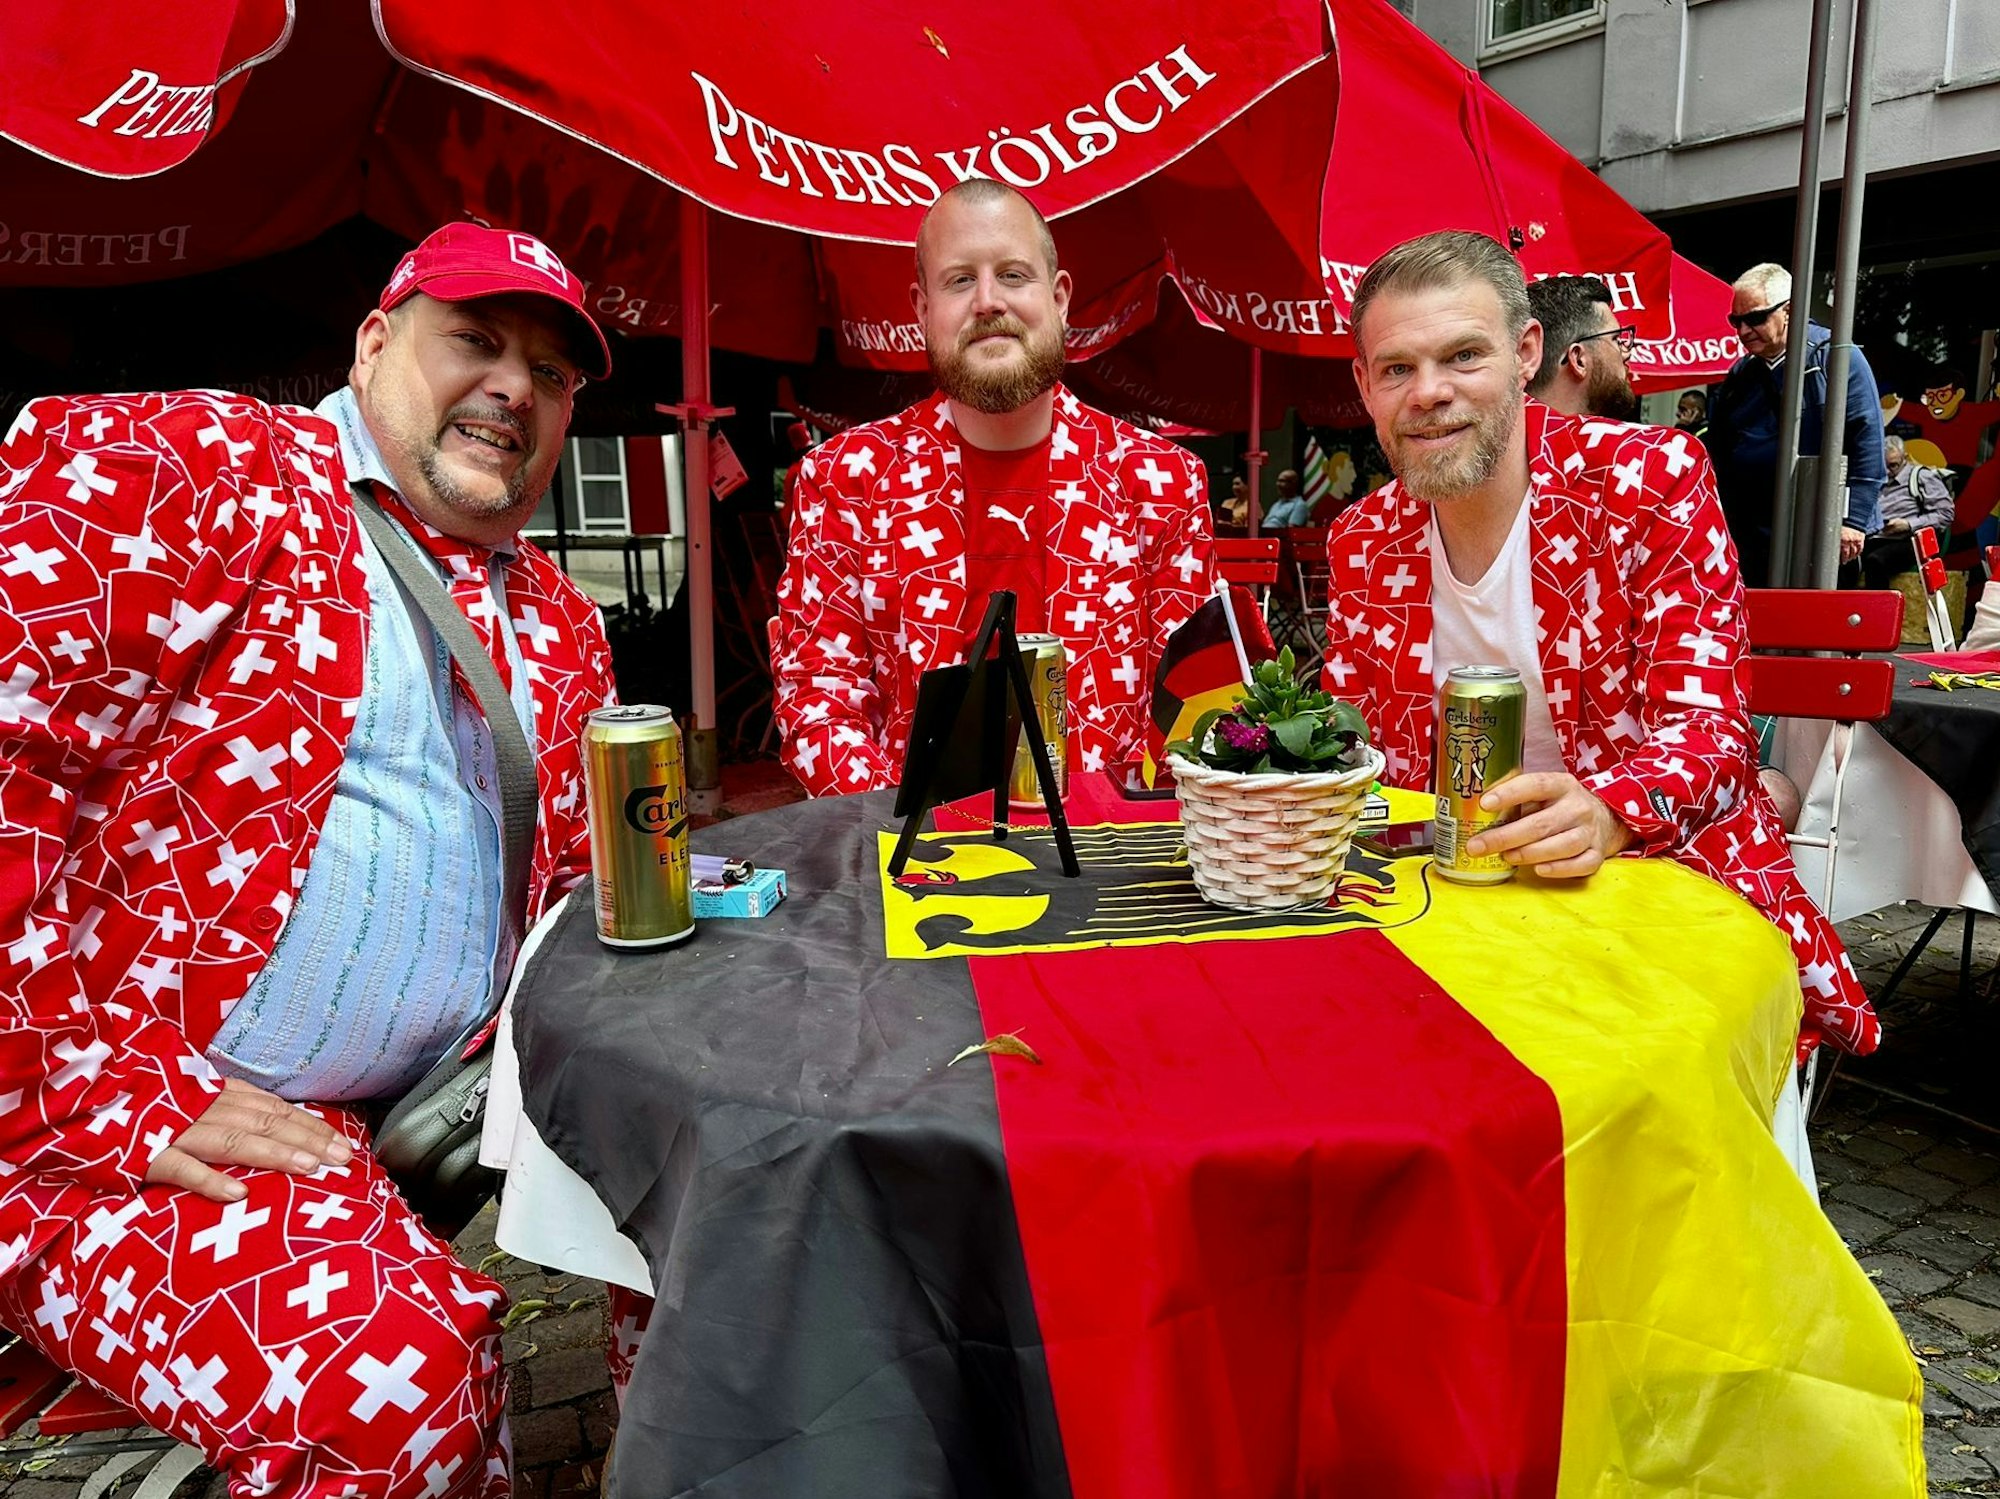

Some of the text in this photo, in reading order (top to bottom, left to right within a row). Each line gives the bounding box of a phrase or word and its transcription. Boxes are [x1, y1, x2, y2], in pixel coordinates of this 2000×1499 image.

[691, 43, 1218, 207] PETERS KÖLSCH
[1445, 707, 1498, 727] Carlsberg
